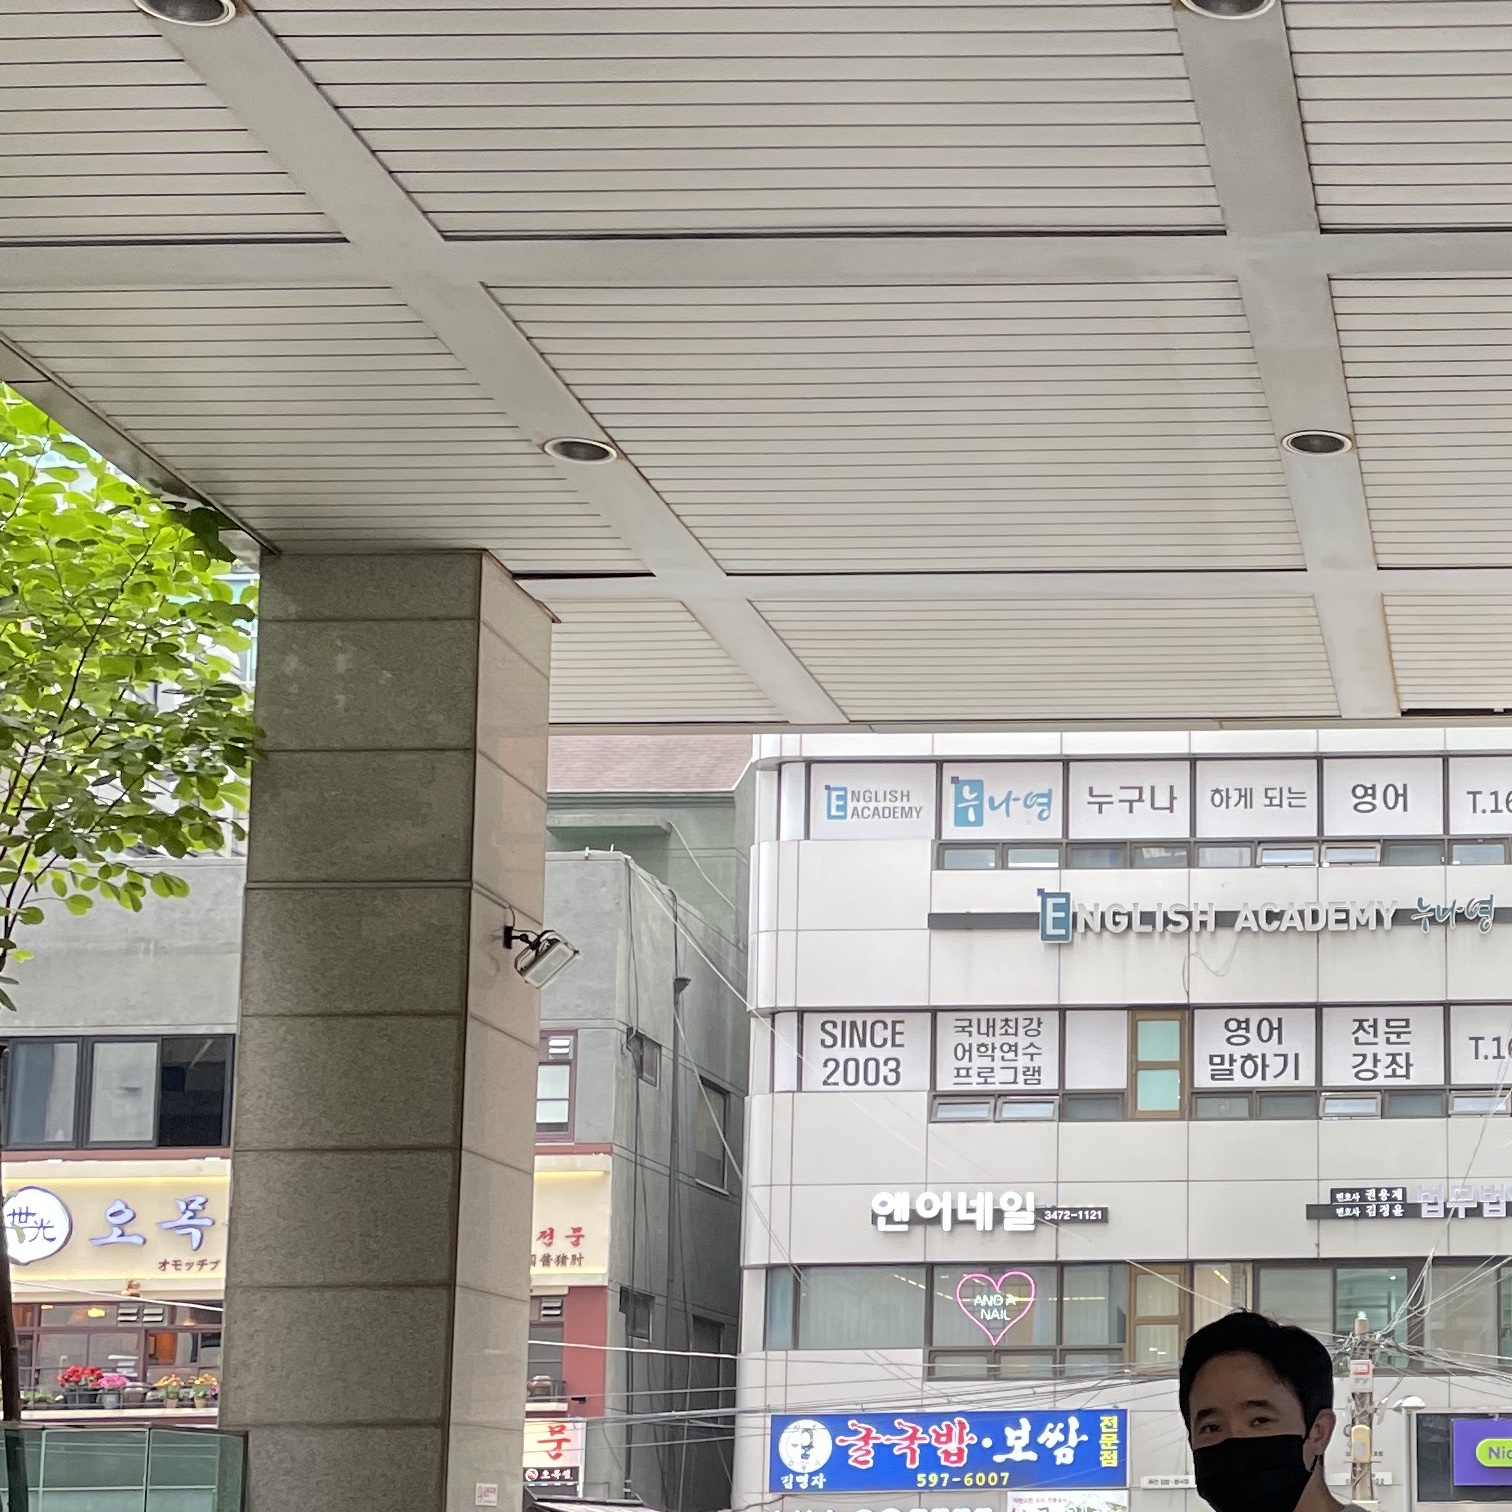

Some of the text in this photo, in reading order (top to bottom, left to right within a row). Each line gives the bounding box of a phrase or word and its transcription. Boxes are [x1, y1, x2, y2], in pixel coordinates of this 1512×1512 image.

[825, 785, 911, 820] ENGLISH
[850, 806, 923, 820] ACADEMY
[1087, 784, 1178, 814] 누구나
[1210, 787, 1254, 810] 하게
[1264, 786, 1308, 810] 되는
[1350, 783, 1410, 814] 영어
[1040, 891, 1216, 943] ENGLISH
[1234, 900, 1398, 933] ACADEMY
[820, 1019, 905, 1049] SINCE
[953, 1017, 1043, 1039] 국내최강
[1224, 1017, 1284, 1046] 영어
[1351, 1017, 1413, 1046] 전문
[953, 1042, 1043, 1063] 어학연수
[1209, 1052, 1300, 1082] 말하기
[1351, 1052, 1414, 1081] 강좌
[821, 1057, 902, 1087] 2003
[952, 1066, 1043, 1086] 프로그램
[1044, 1209, 1102, 1221] 3472-1121
[980, 1309, 1011, 1321] NAIL
[835, 1416, 977, 1469] 굴국밥
[993, 1416, 1089, 1466] 보쌈
[1099, 1415, 1120, 1467] 전문점
[916, 1472, 1010, 1487] 597-6007
